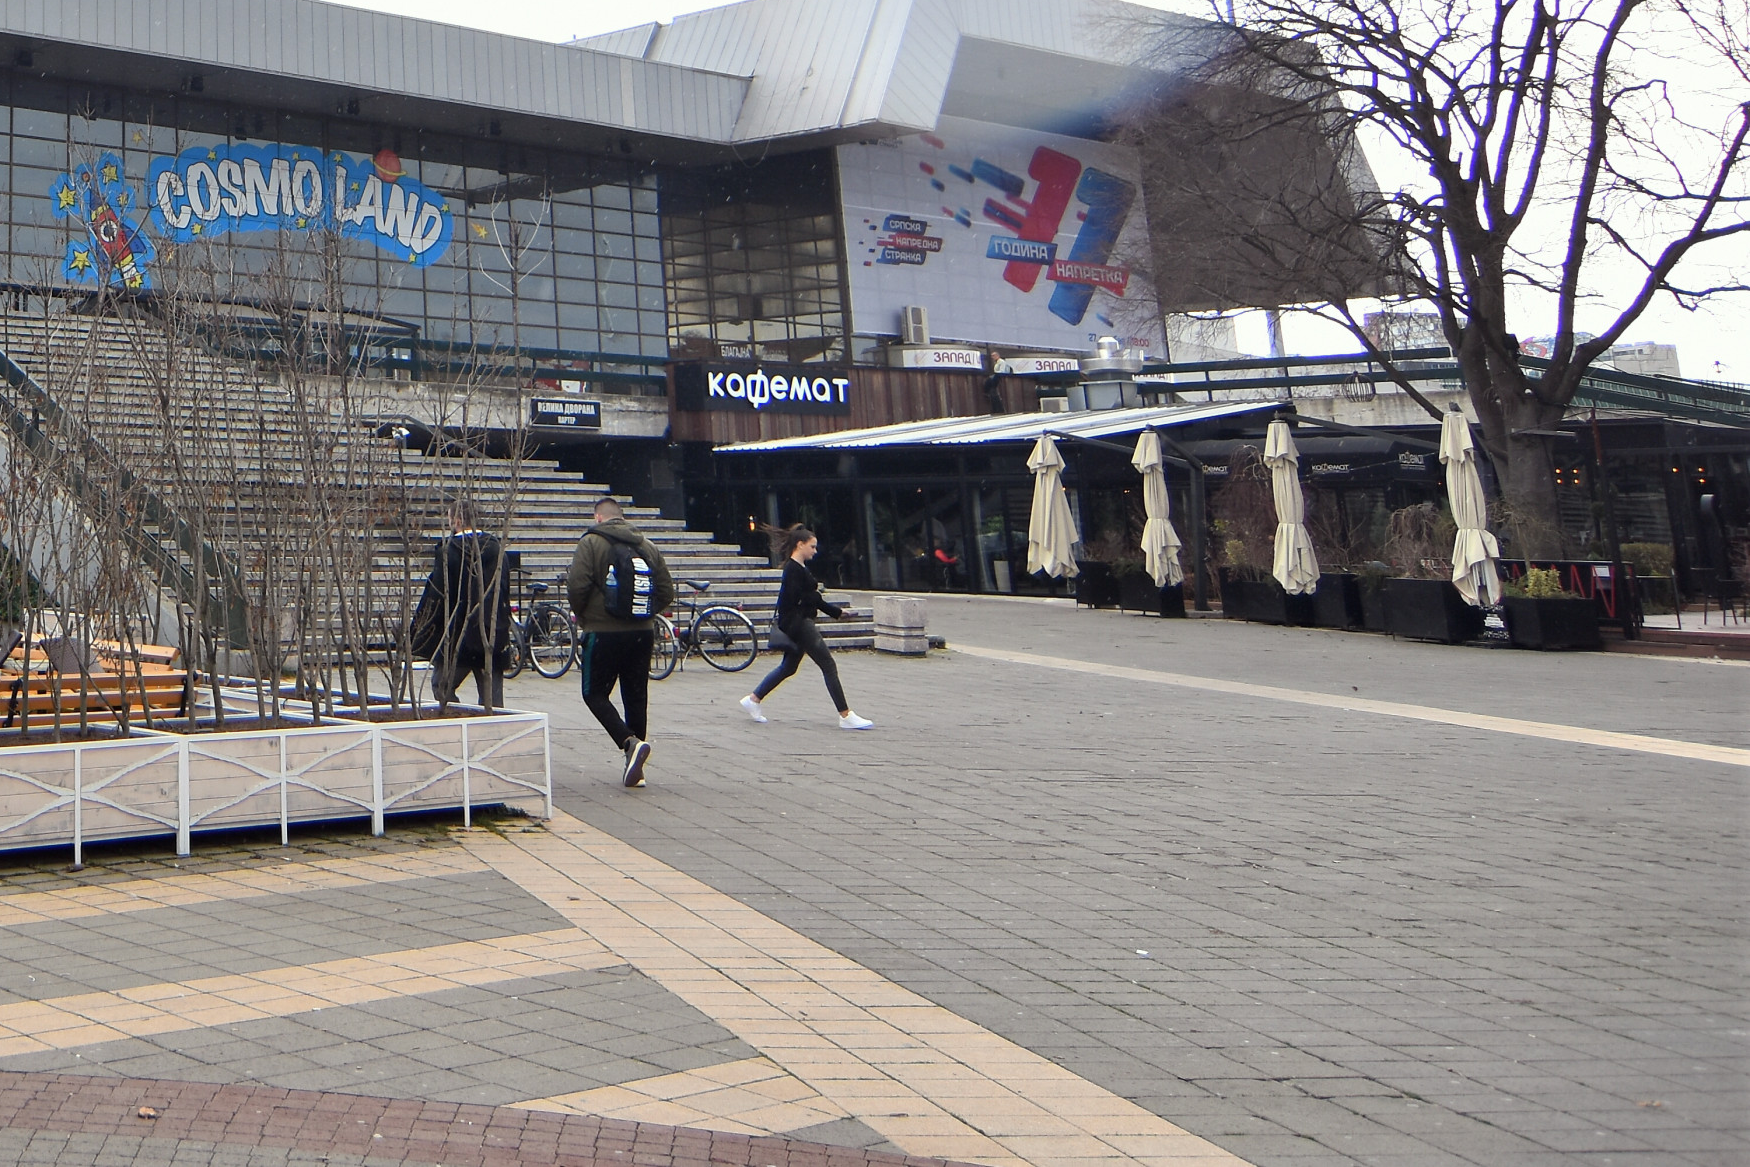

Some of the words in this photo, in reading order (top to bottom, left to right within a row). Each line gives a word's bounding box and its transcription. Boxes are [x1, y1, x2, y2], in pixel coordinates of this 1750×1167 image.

[157, 158, 323, 229] COSMO
[335, 164, 444, 255] LAND
[889, 219, 922, 232] СРПСКА
[895, 236, 939, 250] НАПРЕДНА
[994, 239, 1048, 260] ГОДИНА
[884, 249, 922, 262] СТРАНКА
[1056, 263, 1123, 284] НАПРЕТКА
[564, 403, 595, 415] ДВОРАНА
